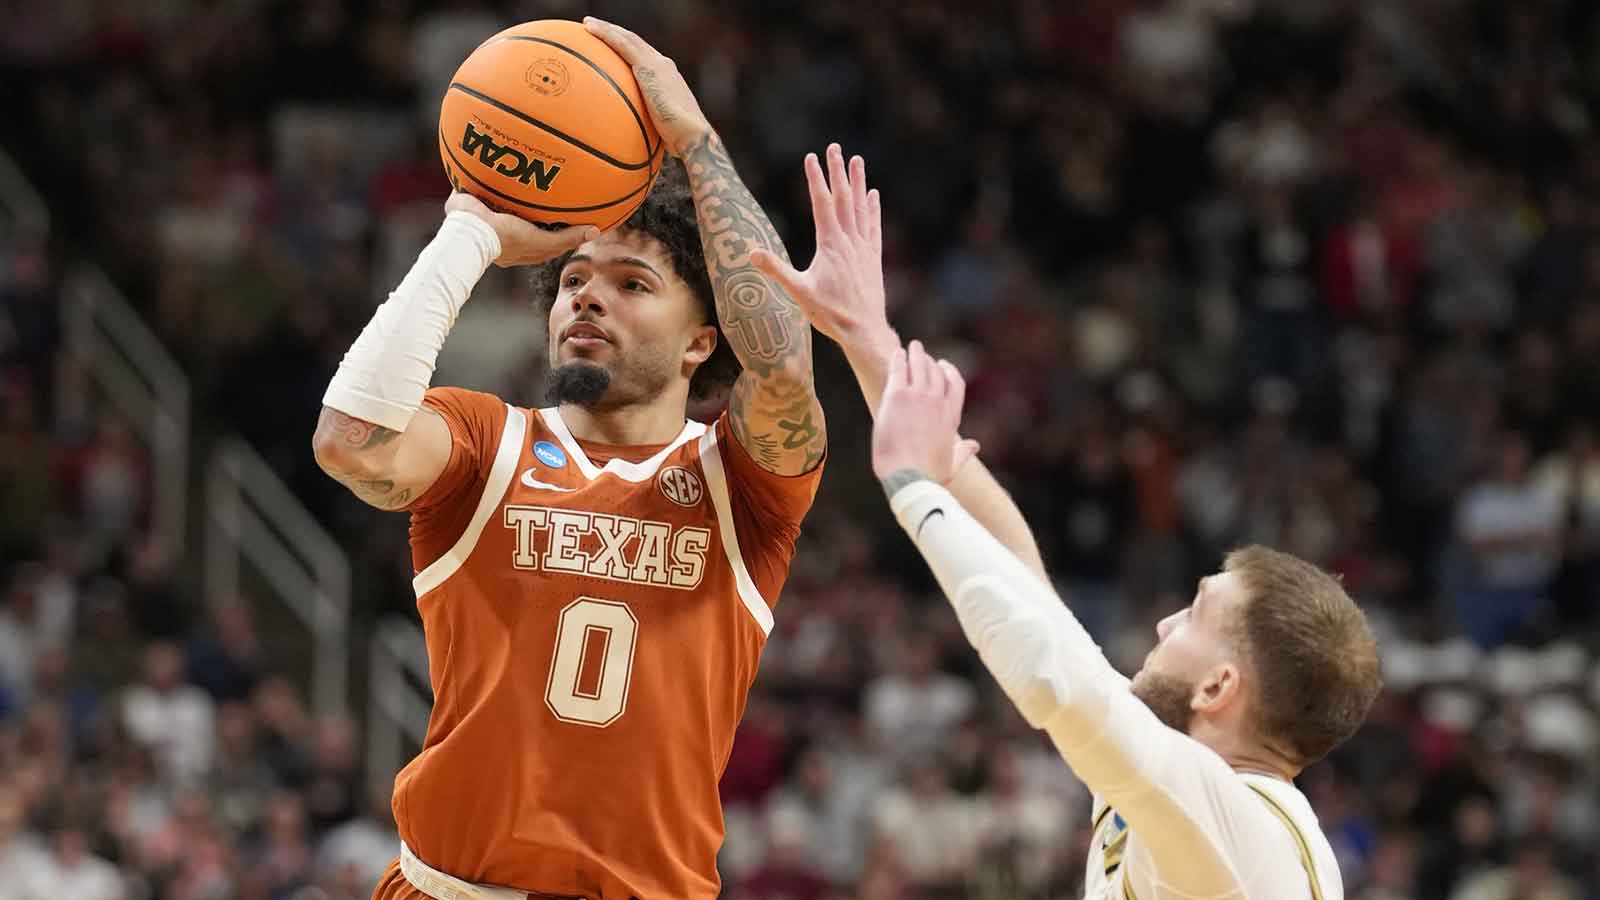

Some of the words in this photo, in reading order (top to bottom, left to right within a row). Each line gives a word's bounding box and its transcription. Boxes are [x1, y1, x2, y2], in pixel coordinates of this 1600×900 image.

[461, 122, 560, 192] NCAA
[536, 446, 564, 466] NCAA
[662, 470, 699, 502] SEC
[504, 505, 711, 591] TEXAS
[544, 595, 639, 728] 0
